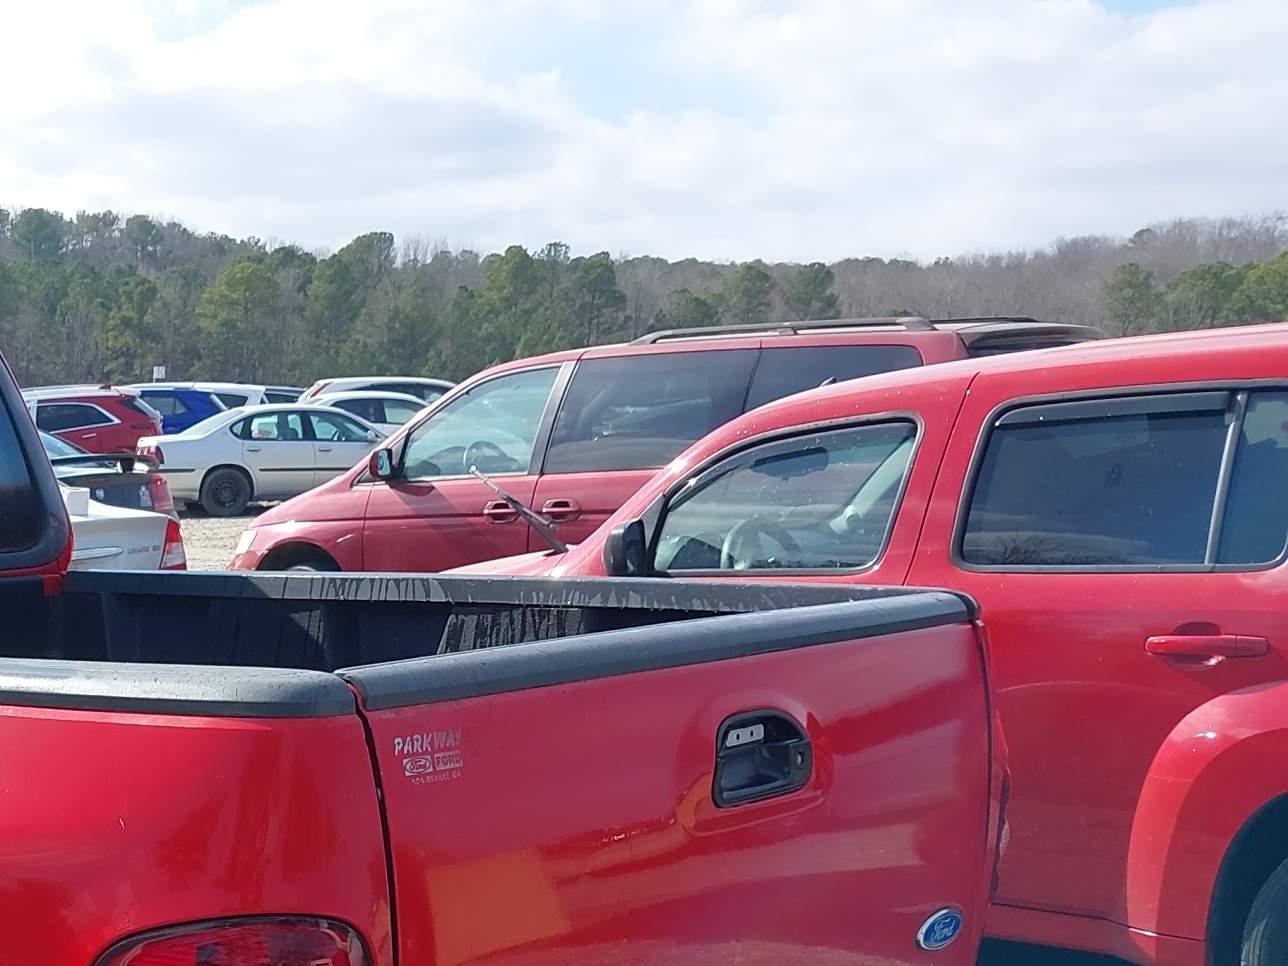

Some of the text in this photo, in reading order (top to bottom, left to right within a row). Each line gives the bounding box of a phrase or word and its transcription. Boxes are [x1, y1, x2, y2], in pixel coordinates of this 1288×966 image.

[394, 729, 462, 756] PARKWAY
[435, 752, 462, 769] FORD
[923, 912, 960, 945] Ford
